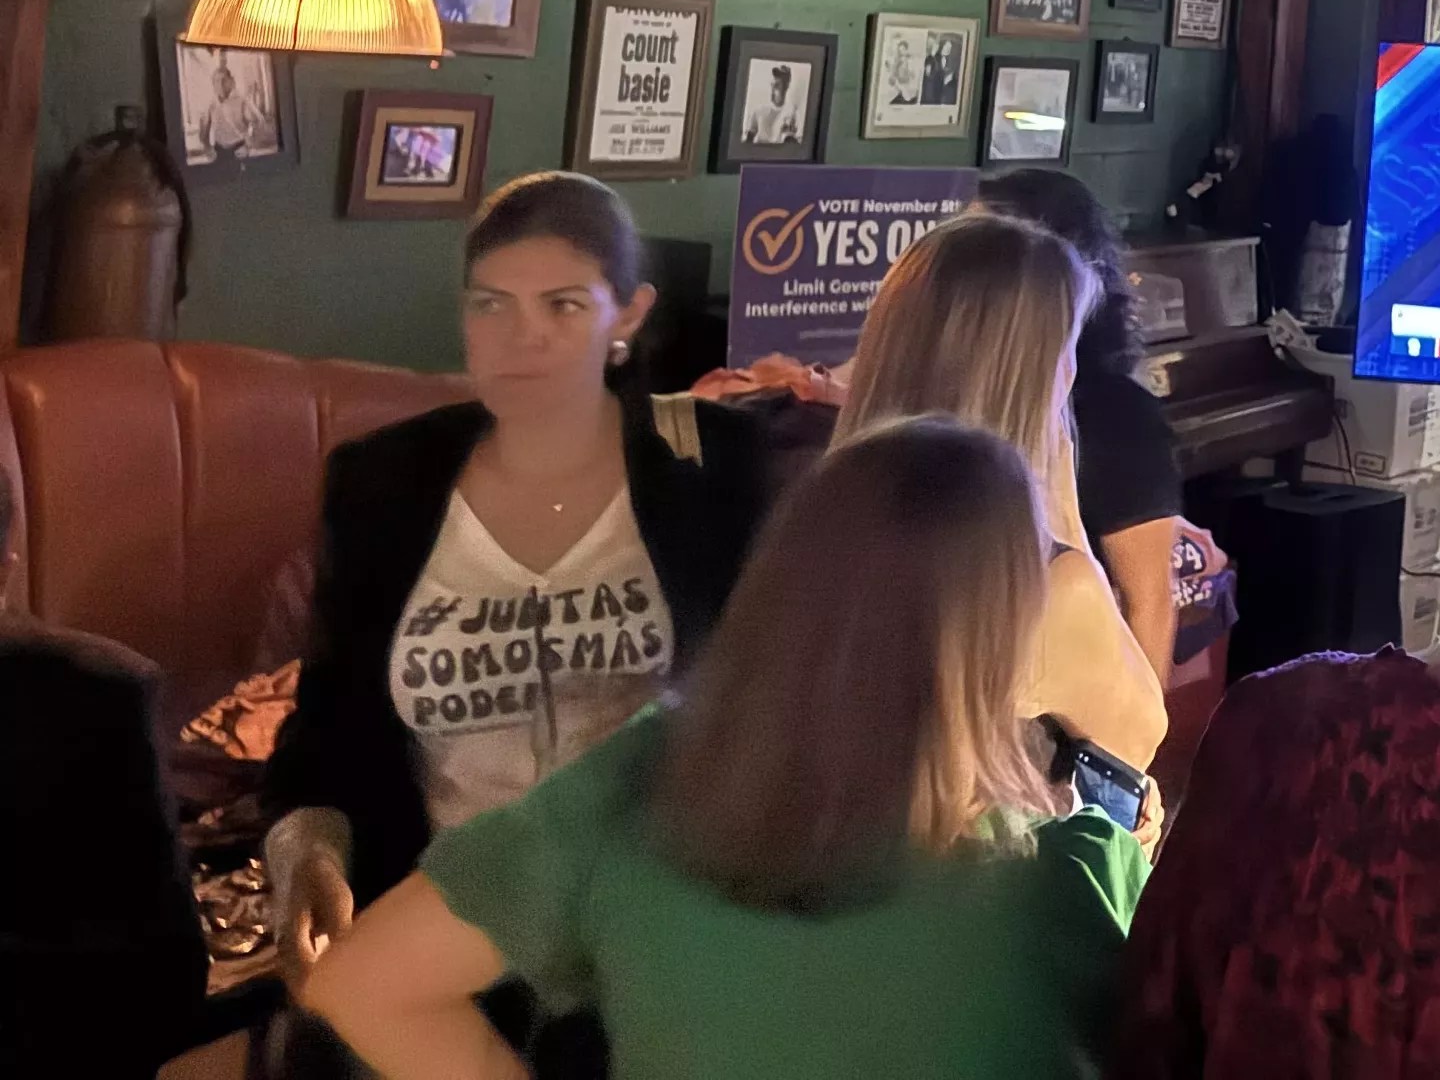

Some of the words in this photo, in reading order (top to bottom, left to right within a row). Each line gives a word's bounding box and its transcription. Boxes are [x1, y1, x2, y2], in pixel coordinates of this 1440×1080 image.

[621, 29, 679, 65] count
[616, 64, 671, 103] basie
[818, 199, 860, 214] VOTE
[863, 199, 937, 214] November
[813, 220, 879, 267] YES
[783, 279, 825, 295] Limit
[745, 302, 847, 317] Interference
